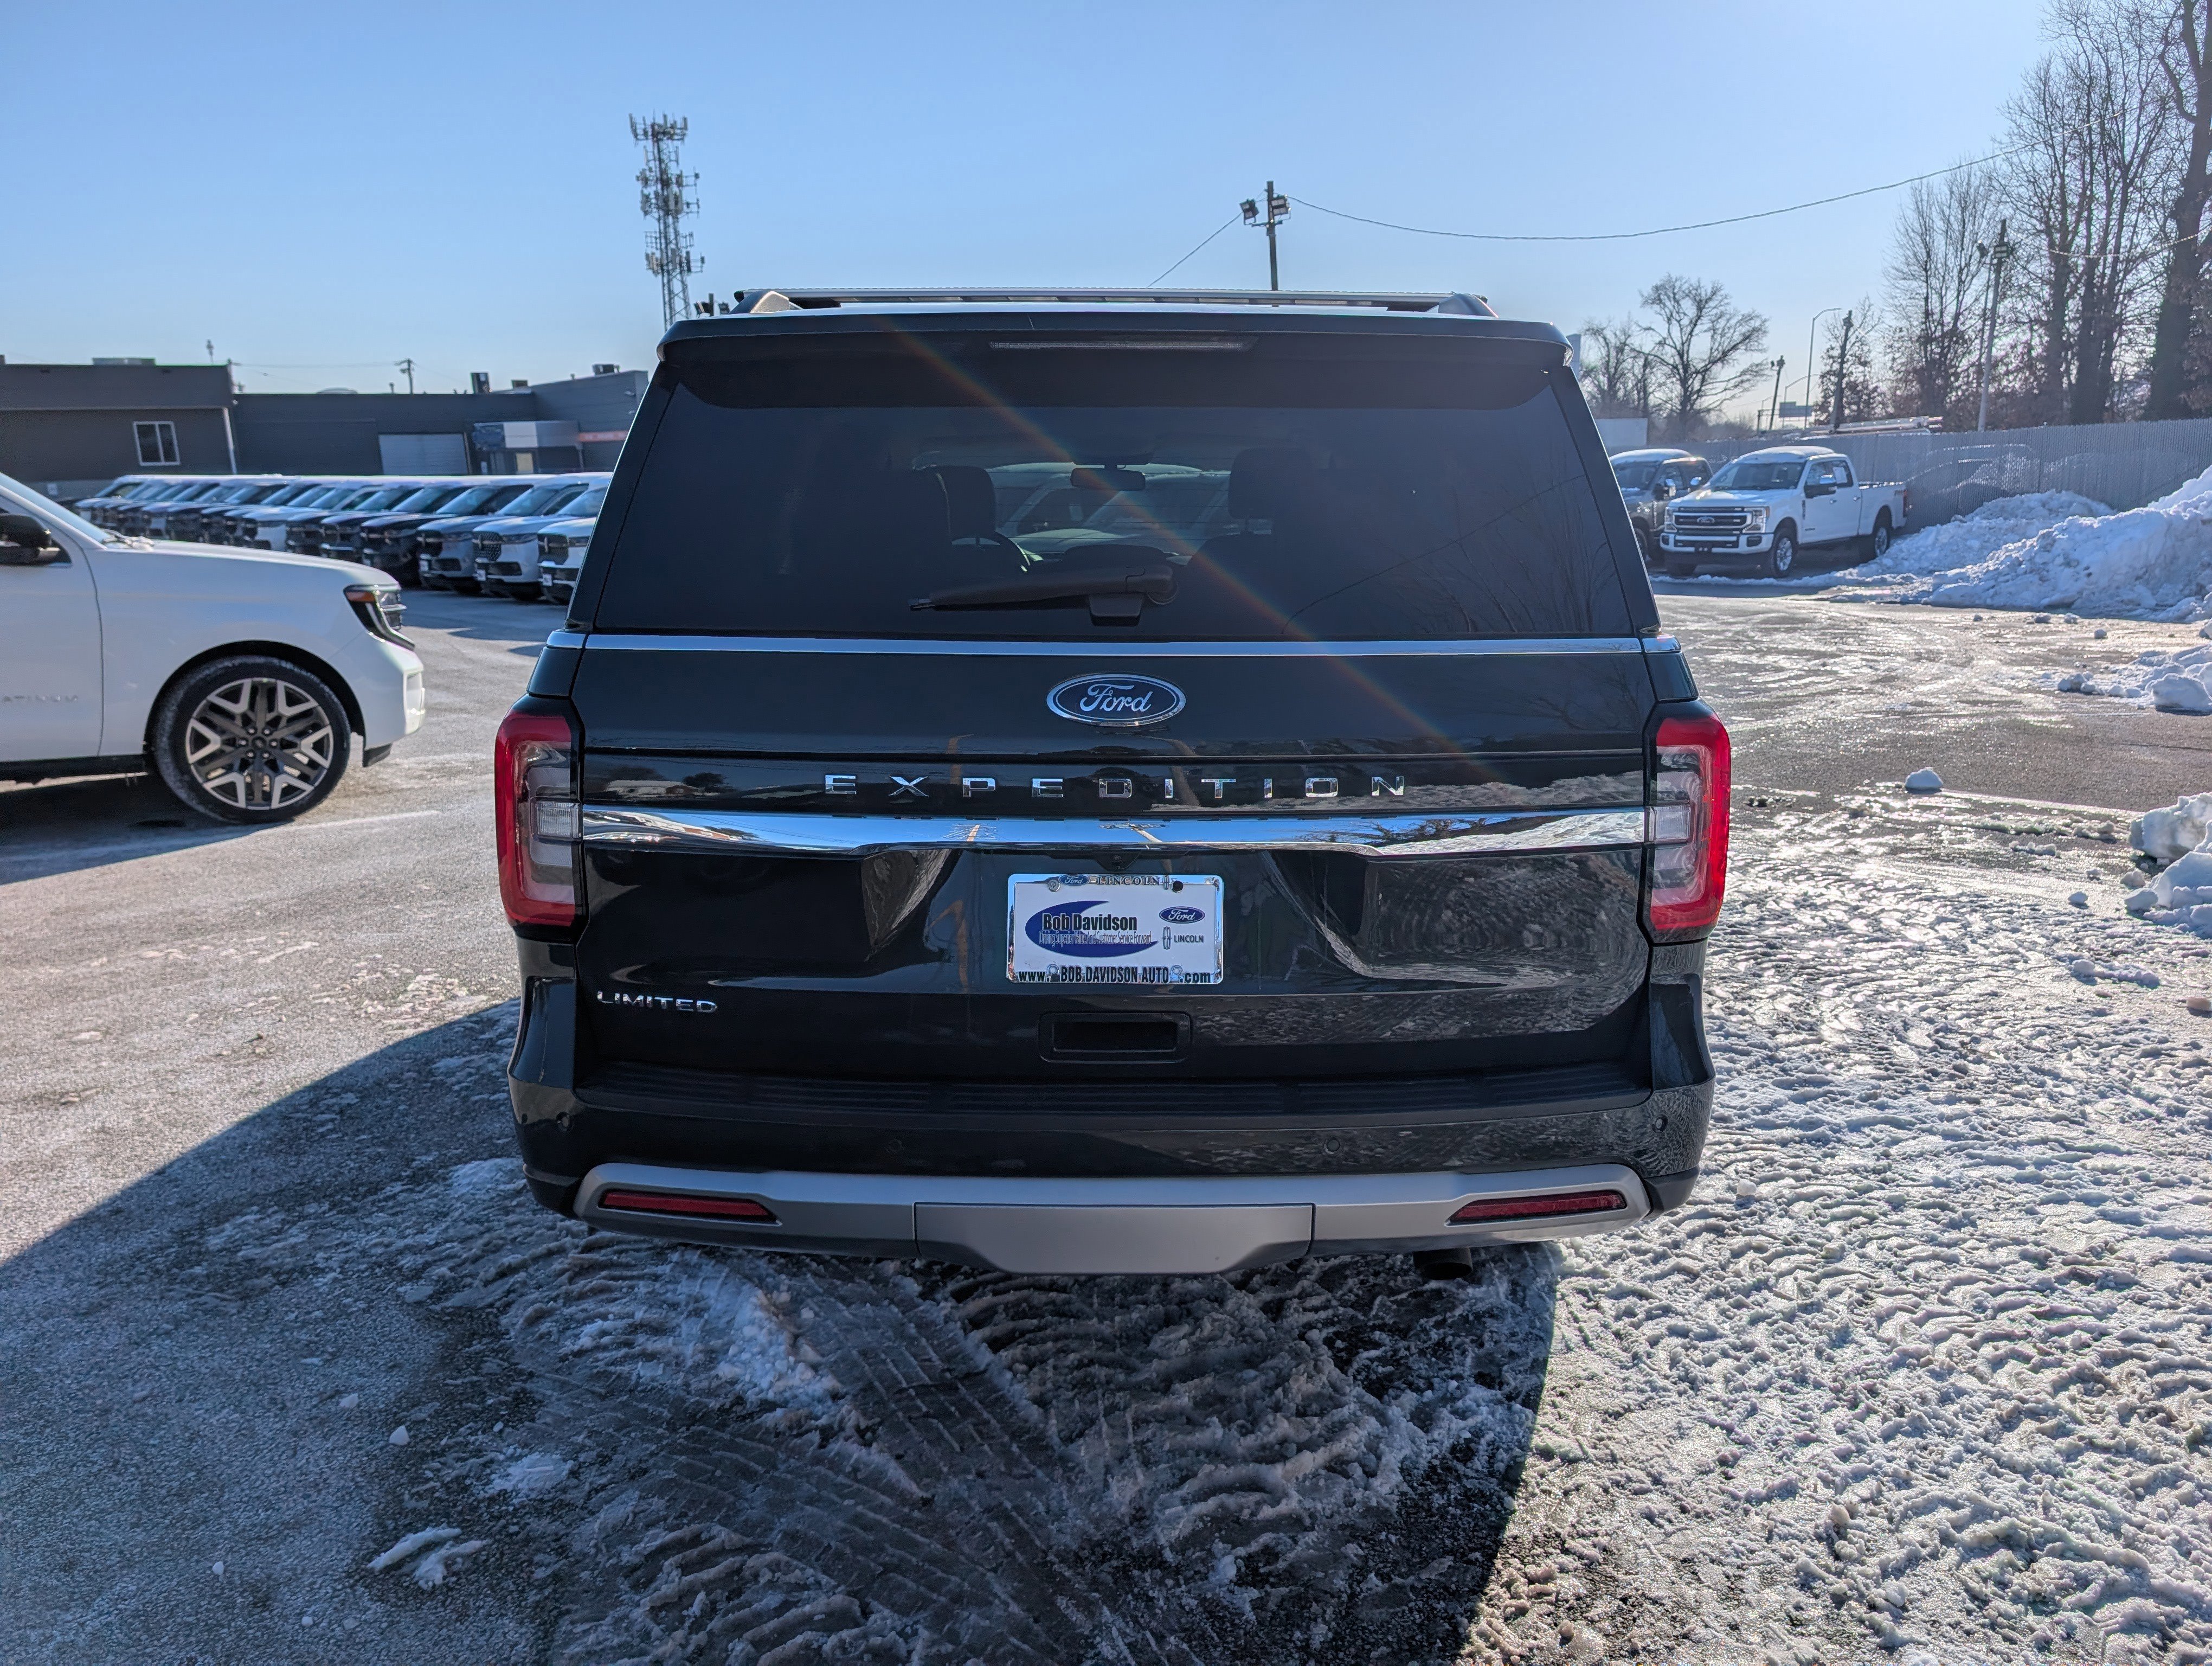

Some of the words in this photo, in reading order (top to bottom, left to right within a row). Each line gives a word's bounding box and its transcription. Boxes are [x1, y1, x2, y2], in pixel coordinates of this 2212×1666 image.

[1080, 683, 1153, 712] Ford
[824, 773, 1405, 799] EXPEDITION
[1064, 875, 1084, 885] Ford
[1097, 875, 1161, 885] LINCOLN
[1043, 913, 1070, 931] Bob
[1072, 913, 1137, 931] Davidson
[1168, 909, 1196, 920] Ford
[1118, 931, 1133, 944] Service
[1134, 931, 1152, 944] Forward
[1174, 934, 1204, 943] LINCOLN
[1060, 966, 1082, 983] BOB
[1085, 966, 1139, 983] DAVIDSON
[1141, 966, 1169, 983] AUTO
[596, 991, 718, 1013] LIMITED
